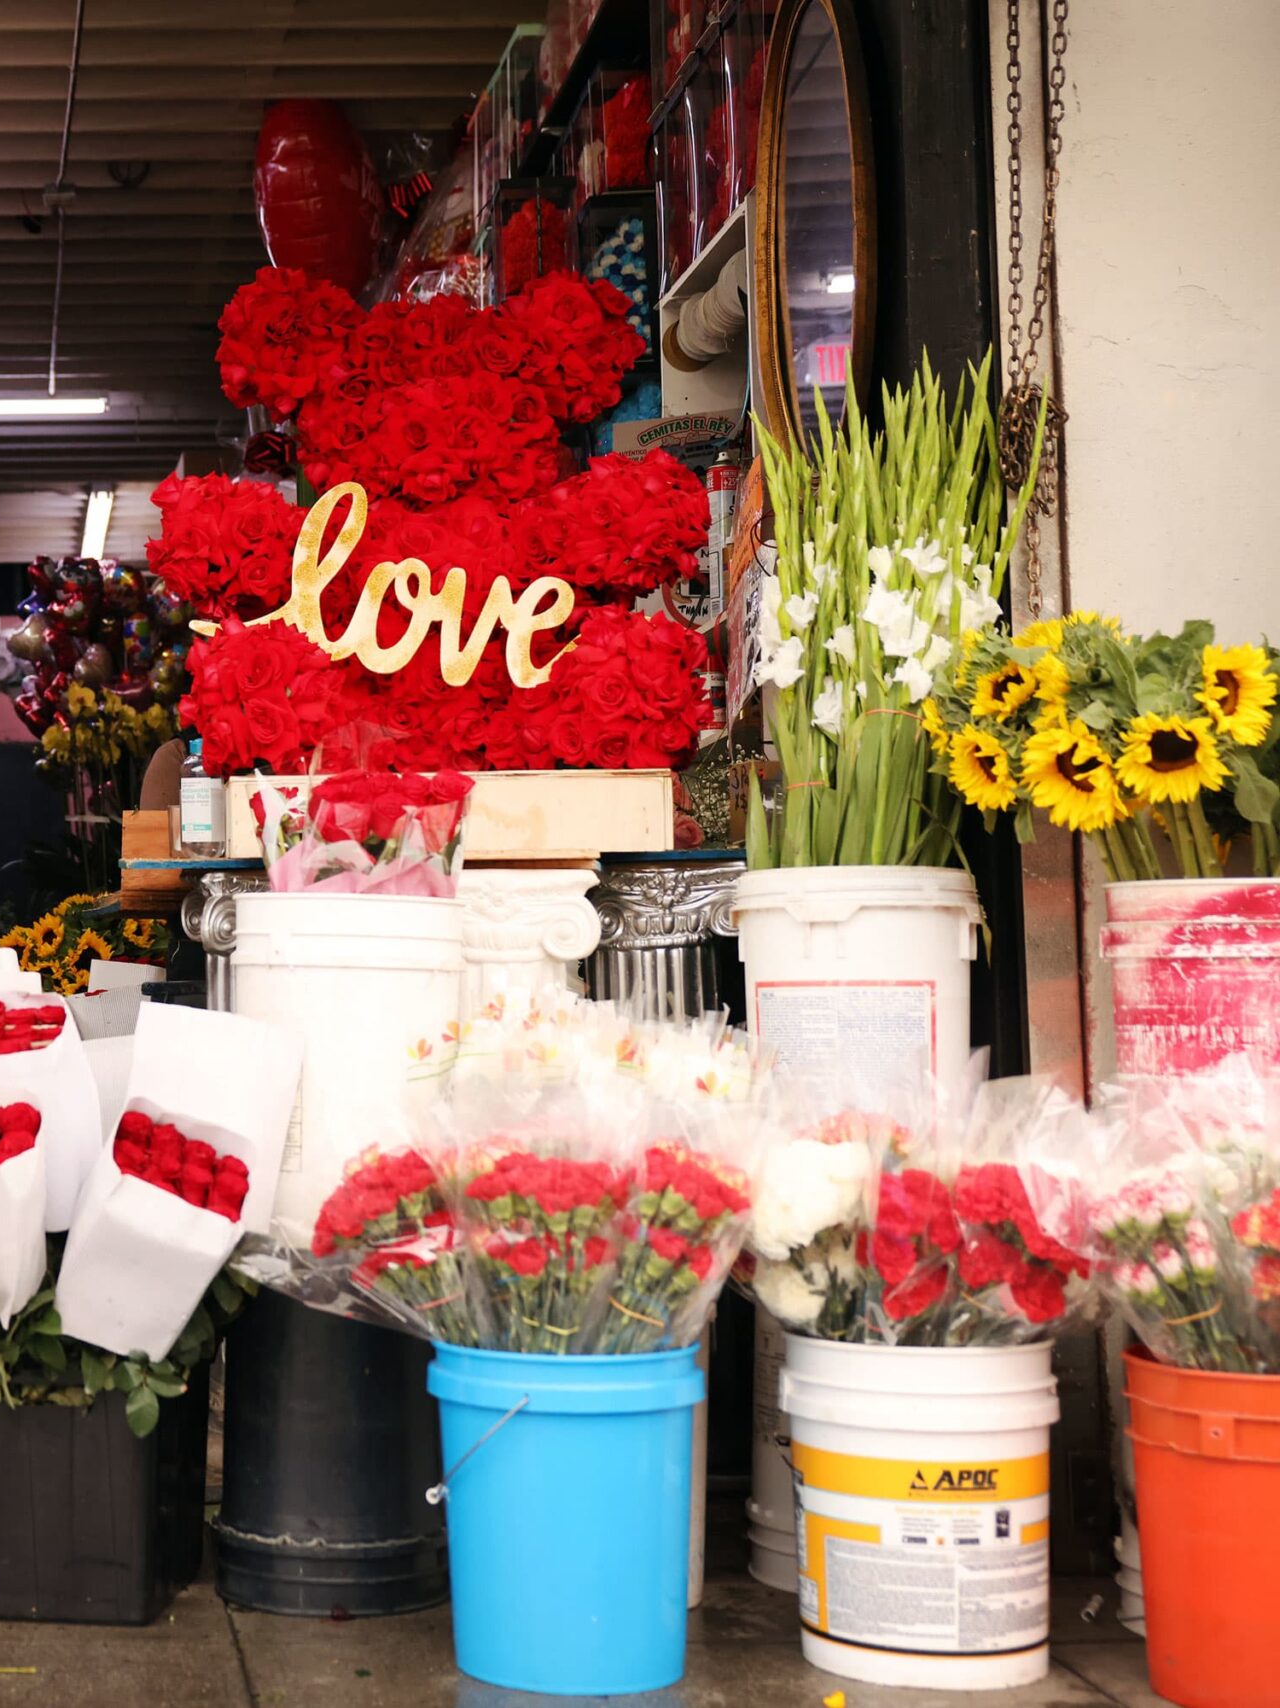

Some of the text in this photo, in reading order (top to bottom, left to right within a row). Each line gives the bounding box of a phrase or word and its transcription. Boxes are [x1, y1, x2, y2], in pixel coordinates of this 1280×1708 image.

[639, 420, 690, 445] CEMITAS
[693, 419, 705, 430] EL
[708, 420, 733, 434] REY
[189, 481, 581, 688] love
[933, 1469, 999, 1491] APOC
